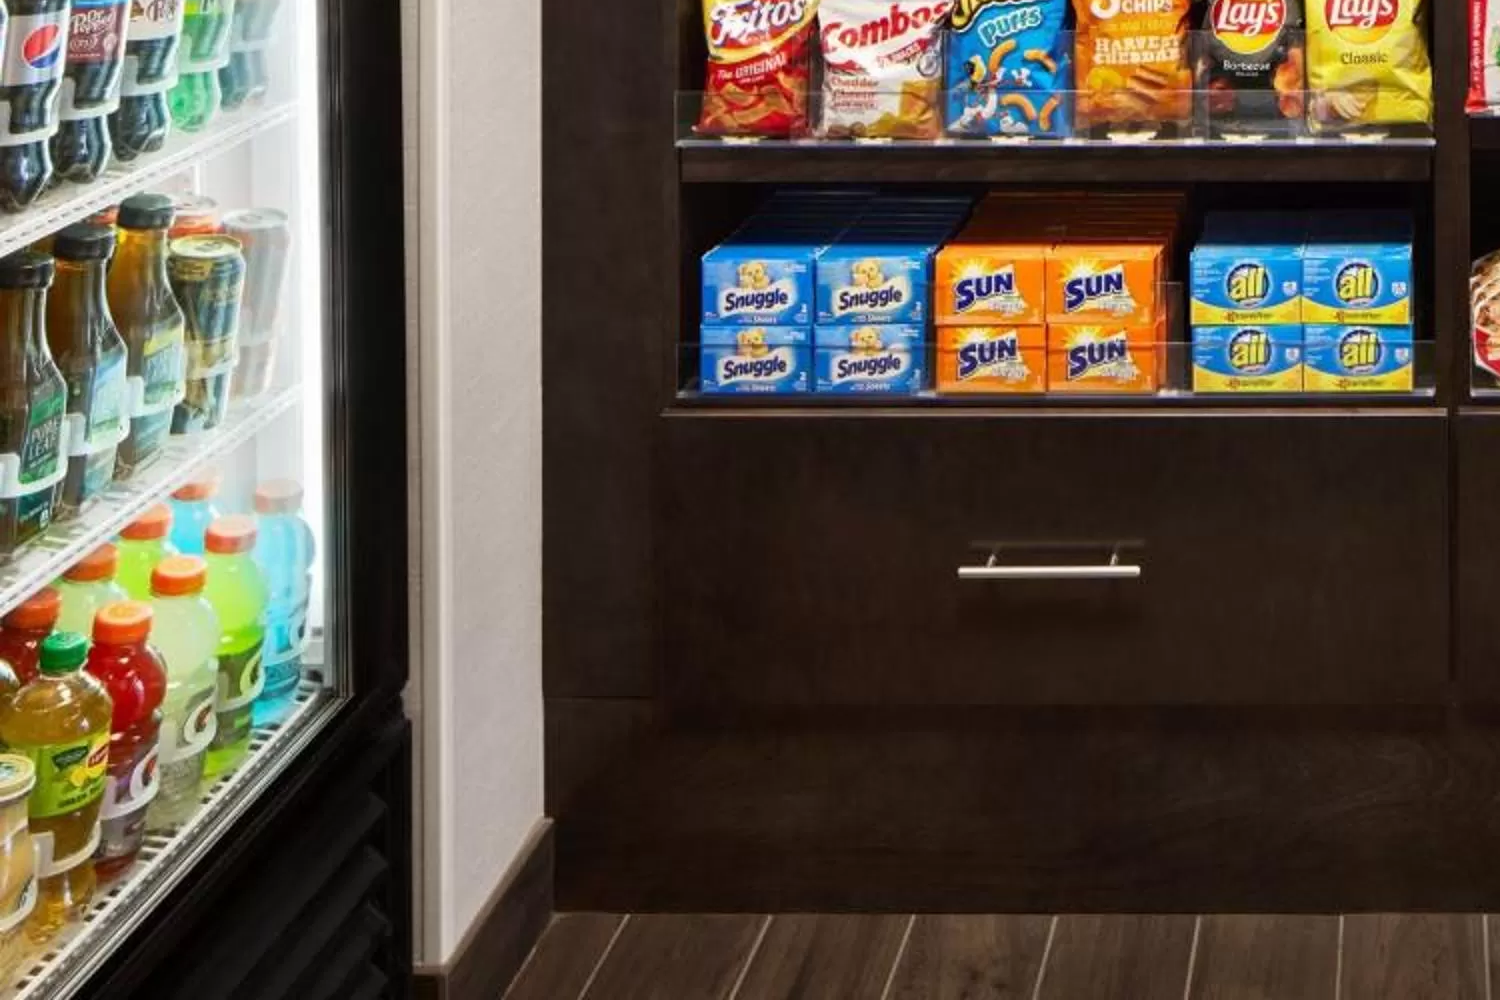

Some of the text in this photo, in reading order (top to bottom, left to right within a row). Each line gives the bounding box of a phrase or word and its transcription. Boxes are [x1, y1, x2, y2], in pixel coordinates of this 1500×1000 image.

[822, 0, 952, 54] Combos
[735, 53, 787, 80] ORIGINAL
[1223, 59, 1270, 71] Barbecue
[1340, 51, 1388, 65] Classic
[724, 287, 788, 312] Snuggle
[838, 286, 903, 311] Snuggle
[956, 272, 1014, 311] SUN
[1066, 272, 1123, 310] SUN
[1230, 267, 1266, 301] all
[1339, 266, 1373, 301] all
[723, 354, 787, 380] Snuggle
[837, 352, 901, 379] Snuggle
[959, 339, 1017, 378] SUN
[1068, 339, 1126, 377] SUN
[1232, 333, 1267, 368] all
[1342, 333, 1377, 368] all
